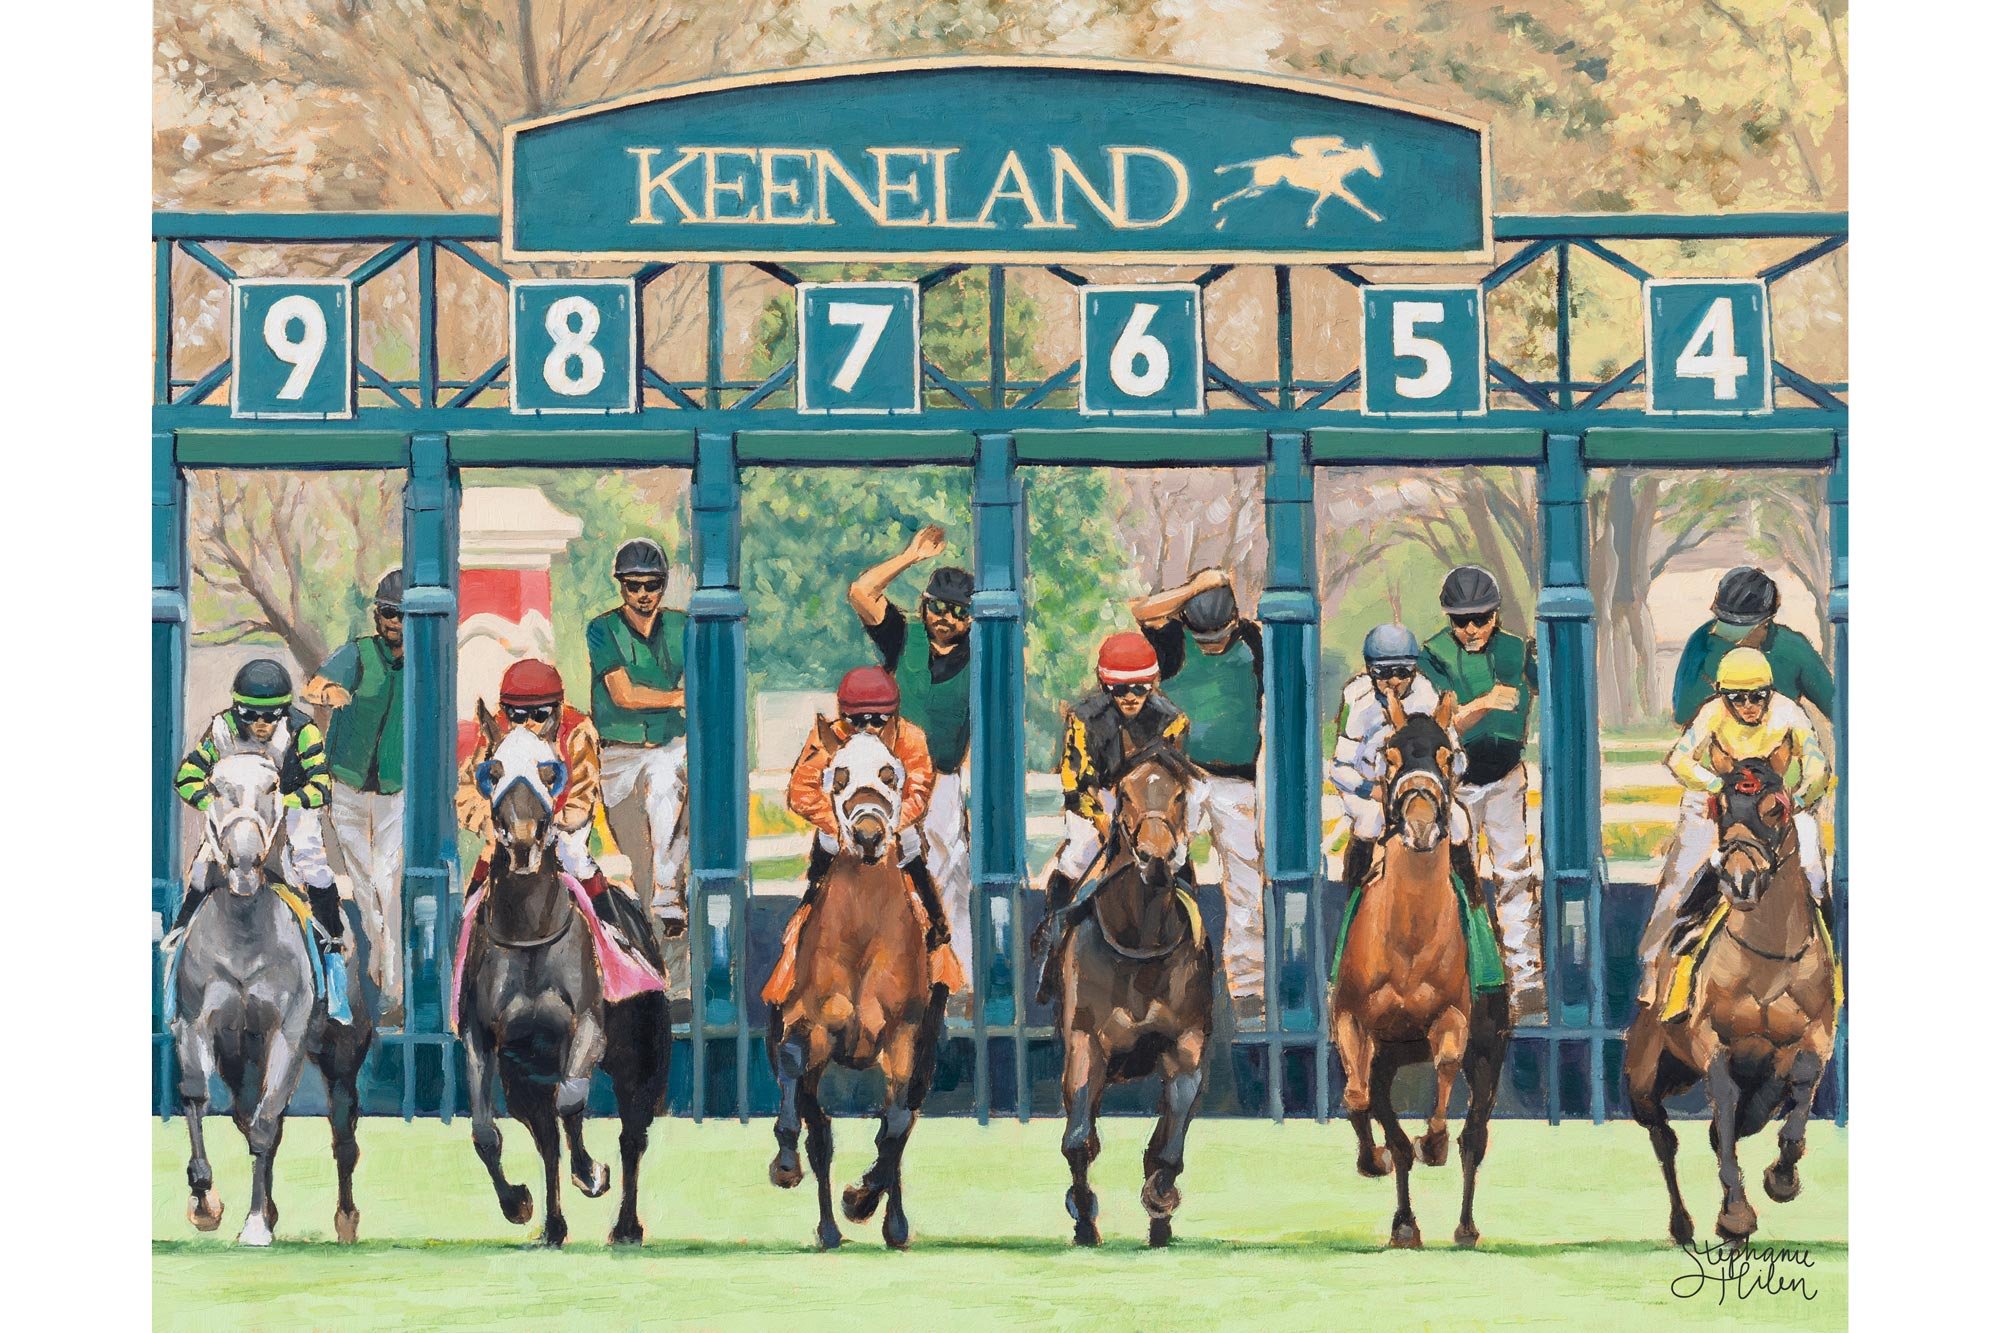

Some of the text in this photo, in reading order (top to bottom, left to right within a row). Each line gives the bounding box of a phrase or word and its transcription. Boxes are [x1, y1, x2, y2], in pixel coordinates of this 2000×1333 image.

[626, 145, 1190, 230] KEENELAND
[264, 295, 327, 399] 9
[544, 296, 606, 396] 8
[828, 302, 894, 394] 7
[1110, 302, 1170, 398] 6
[1392, 301, 1453, 399] 5
[1675, 297, 1748, 400] 4
[1671, 1235, 1815, 1299] Stephanie
